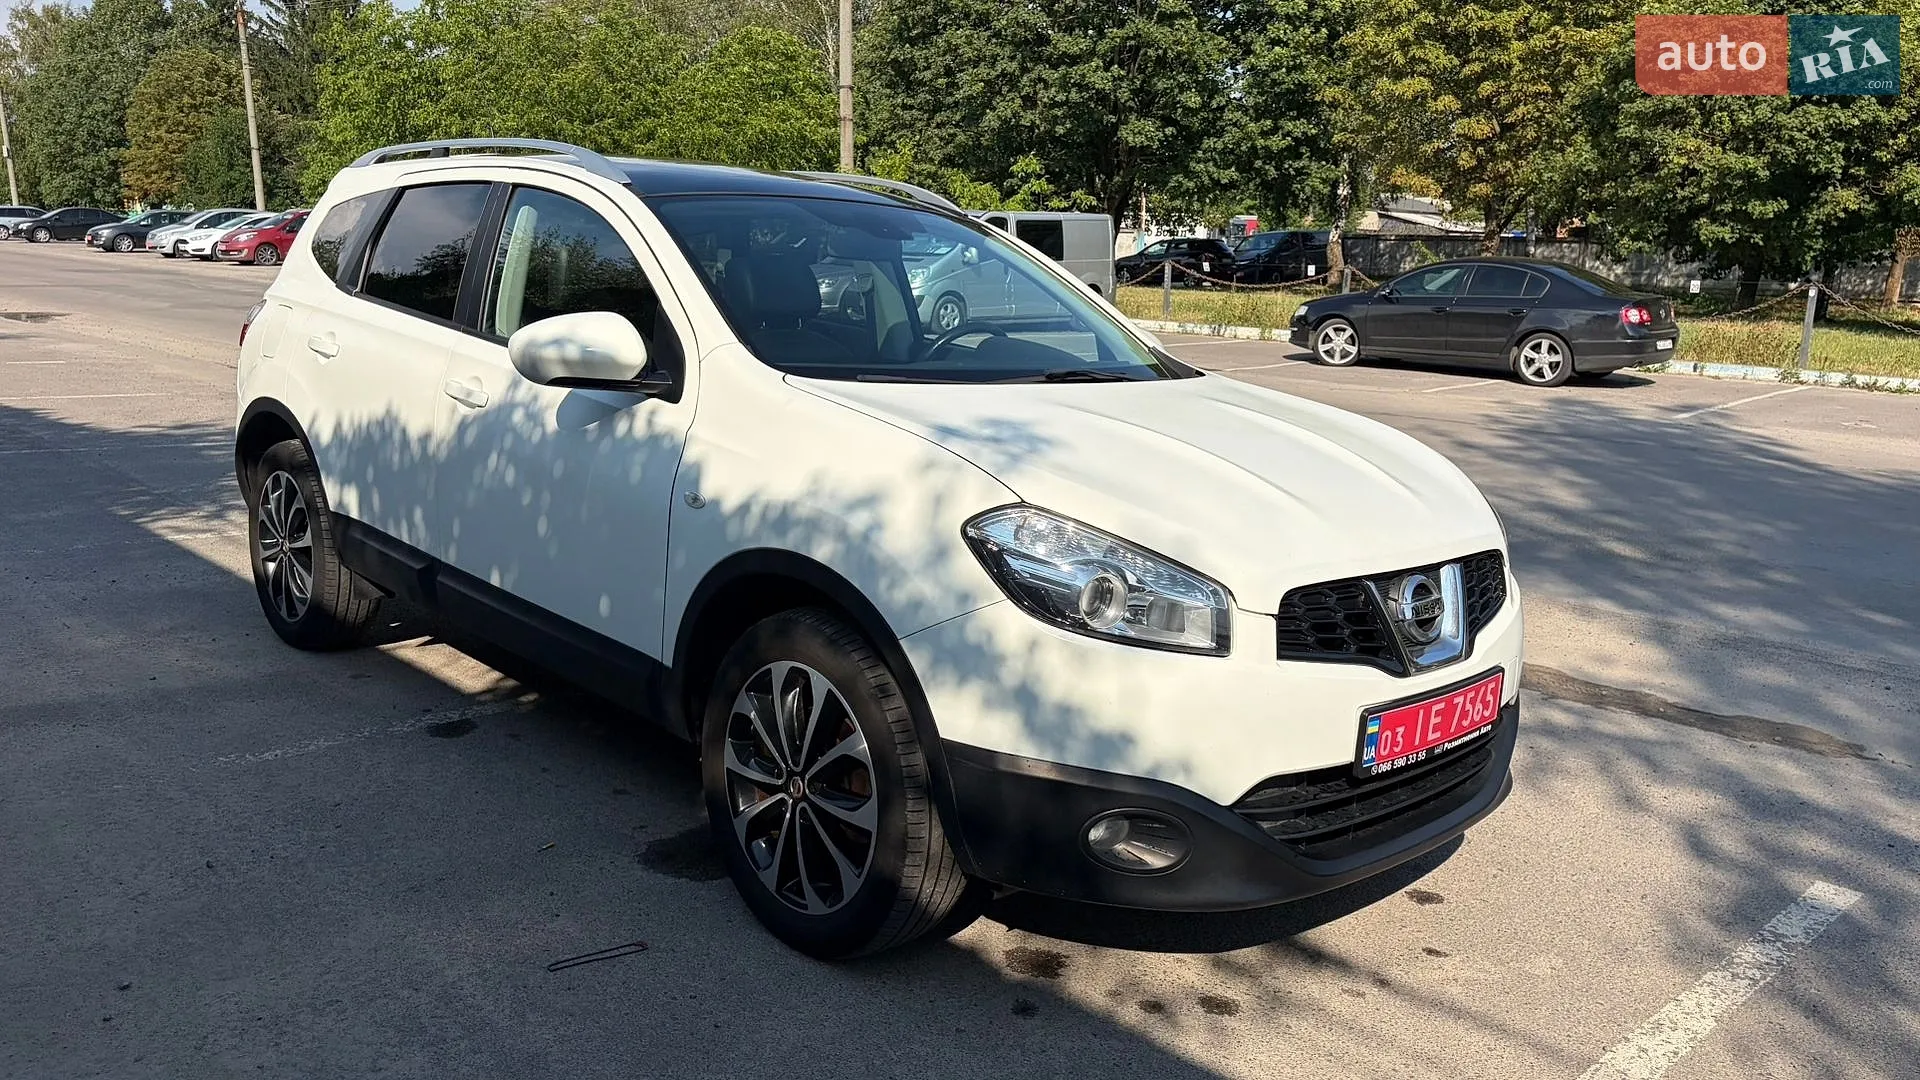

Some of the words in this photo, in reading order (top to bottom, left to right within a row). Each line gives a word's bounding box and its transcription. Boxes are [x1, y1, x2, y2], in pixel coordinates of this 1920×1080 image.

[1380, 726, 1405, 756] 03
[1414, 702, 1446, 746] IE
[1449, 682, 1496, 733] 7565
[1363, 745, 1376, 761] UA
[1378, 762, 1392, 774] 066
[1393, 756, 1407, 769] 590
[1407, 754, 1417, 765] 33
[1418, 750, 1427, 761] 55
